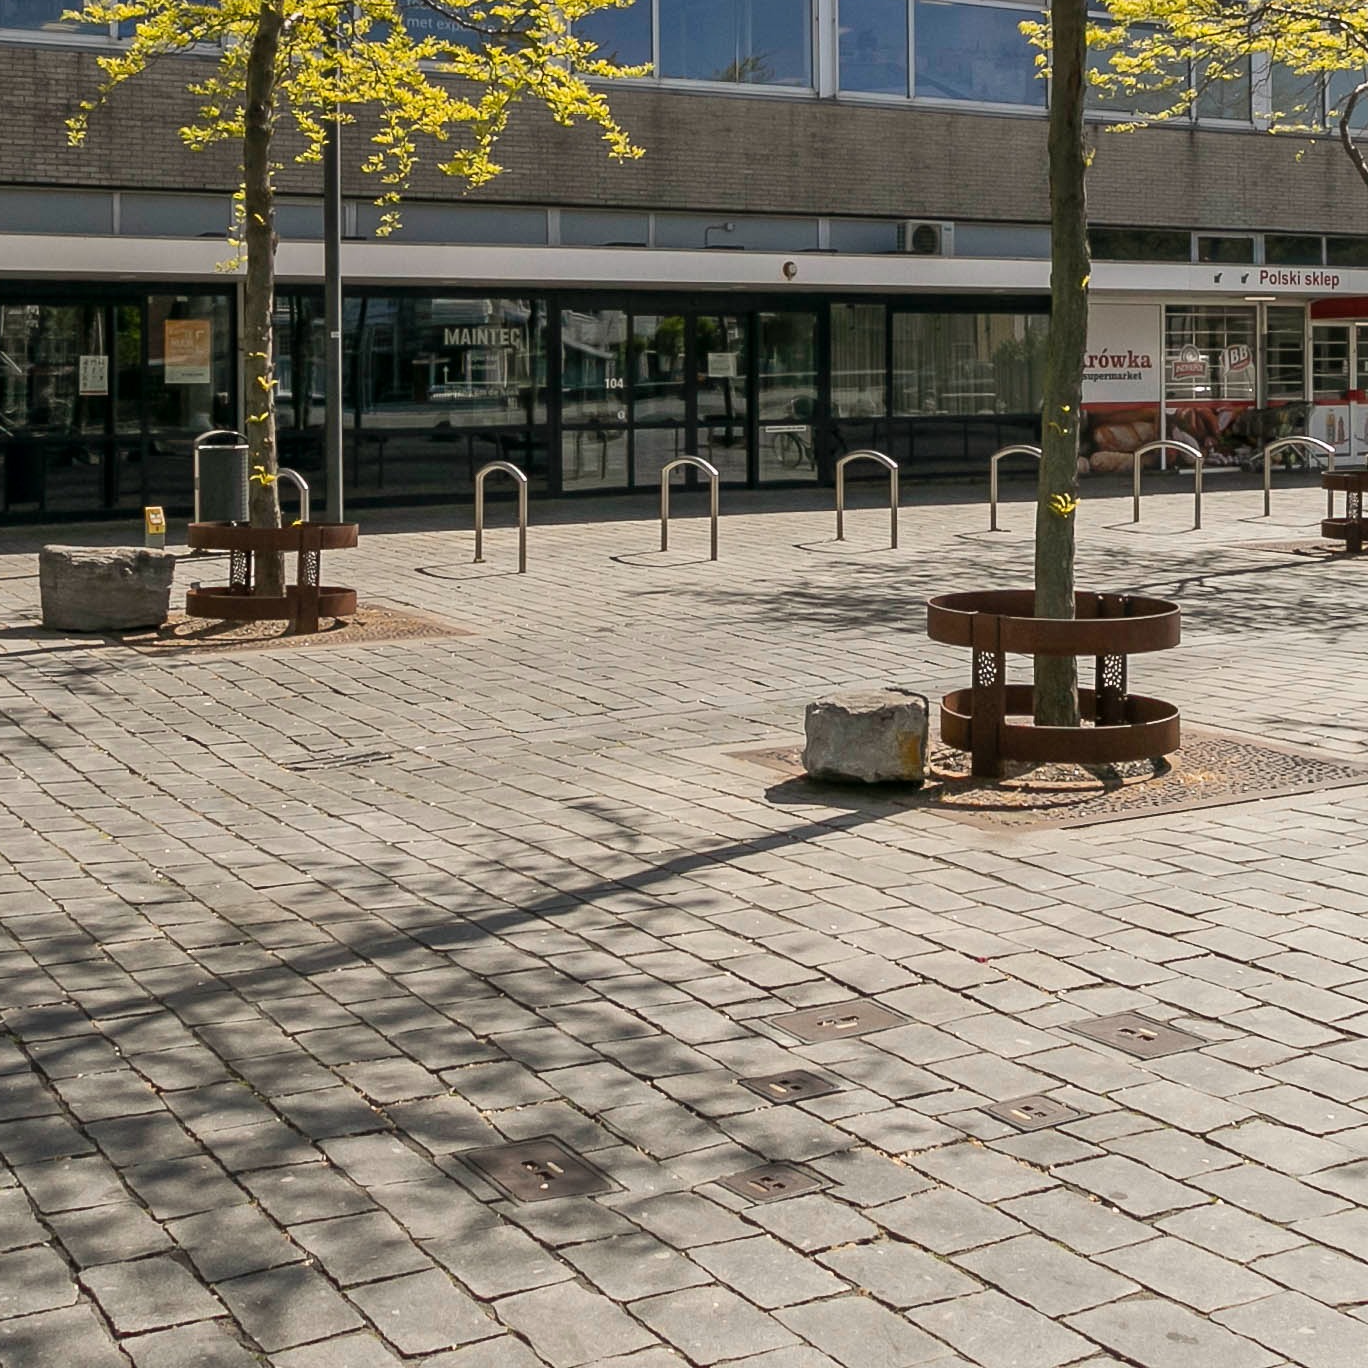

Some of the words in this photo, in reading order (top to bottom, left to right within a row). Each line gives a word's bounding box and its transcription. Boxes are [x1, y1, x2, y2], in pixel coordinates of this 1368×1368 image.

[407, 17, 432, 29] met
[1259, 270, 1301, 285] Polski
[1304, 271, 1340, 289] sklep
[444, 328, 520, 345] MAINTEC
[1083, 349, 1153, 368] rówka
[1082, 371, 1143, 380] supermarket
[604, 378, 624, 389] 104
